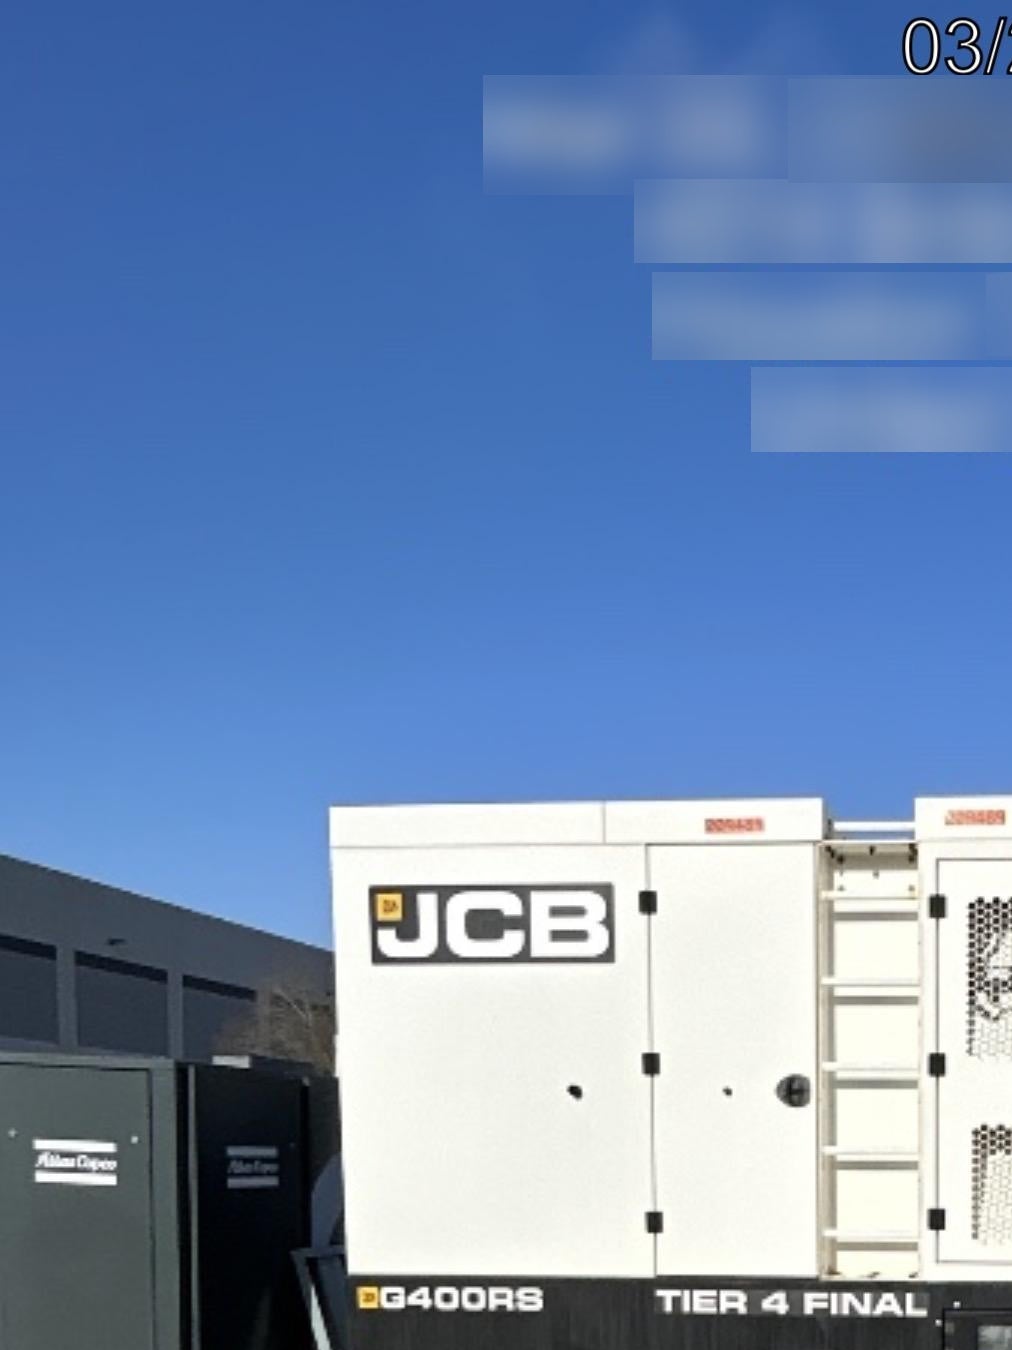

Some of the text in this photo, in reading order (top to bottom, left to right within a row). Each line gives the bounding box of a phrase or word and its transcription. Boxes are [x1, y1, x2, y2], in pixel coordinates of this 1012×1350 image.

[375, 890, 611, 959] JCB
[380, 1286, 545, 1313] G400RS
[655, 1289, 929, 1318] TIER 4 FINAL
